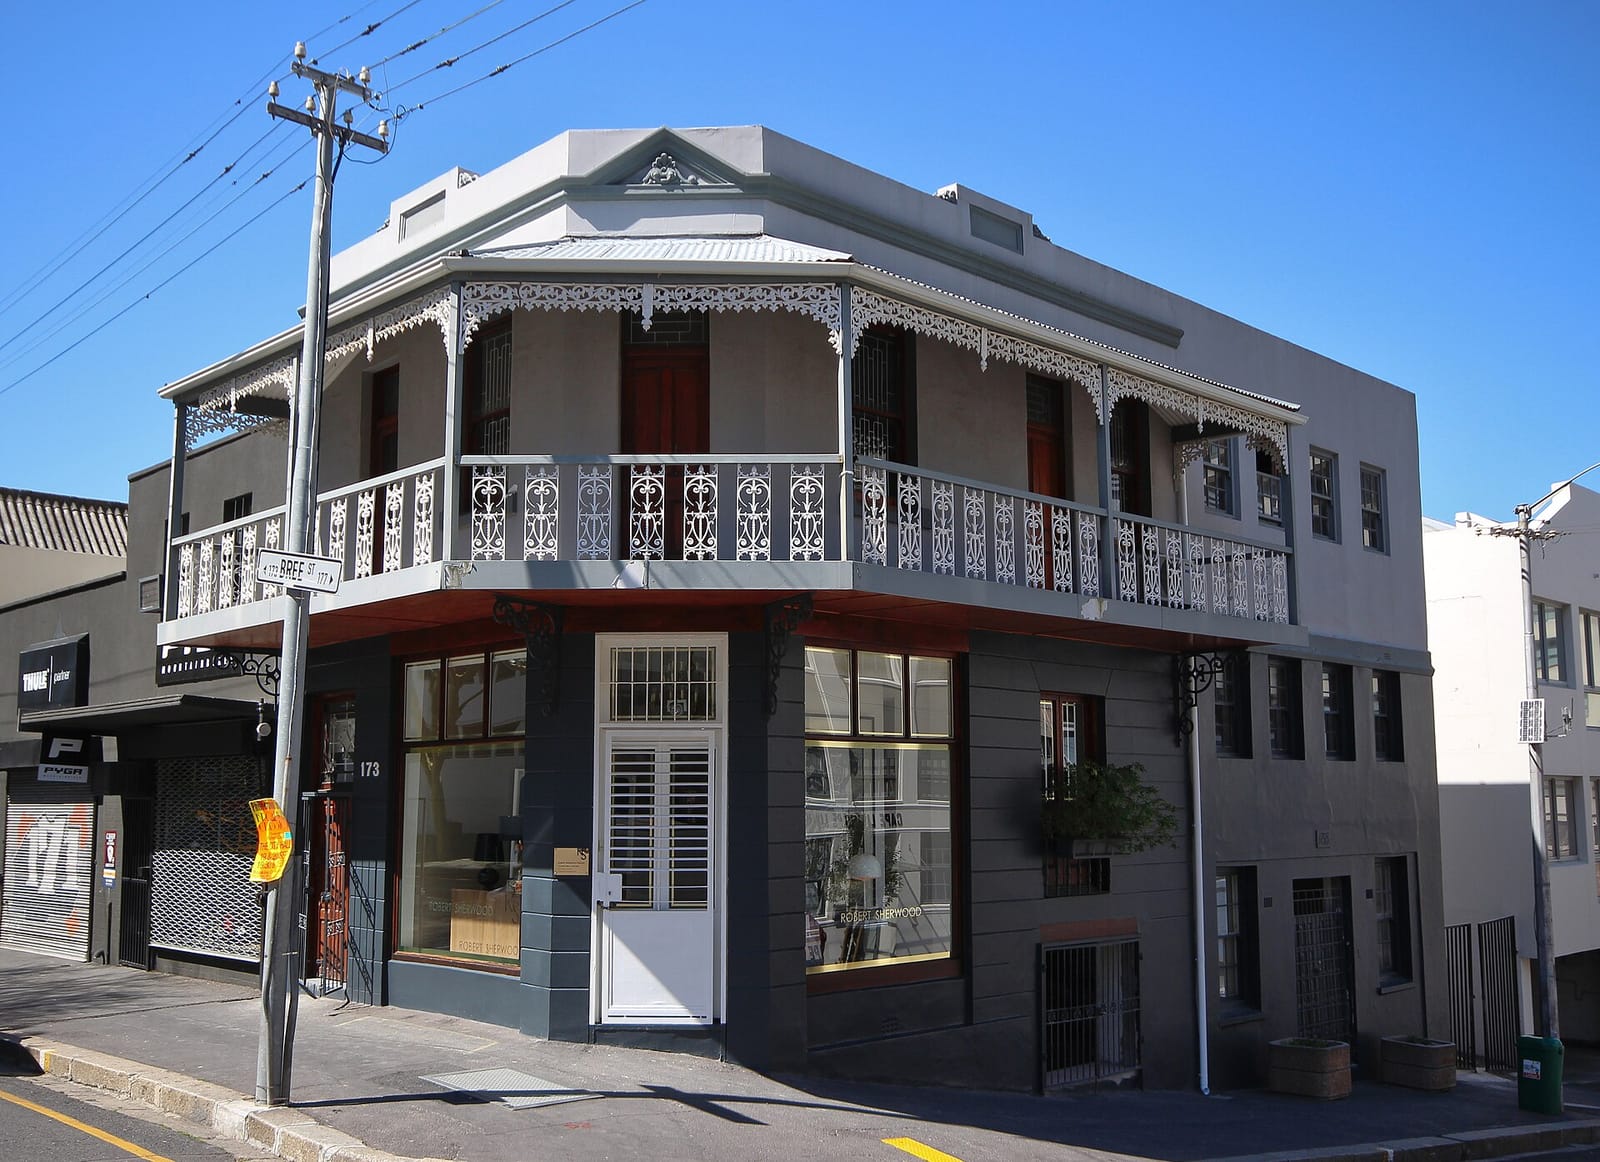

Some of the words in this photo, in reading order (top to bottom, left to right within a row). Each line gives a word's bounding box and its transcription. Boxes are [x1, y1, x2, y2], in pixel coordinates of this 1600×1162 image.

[280, 559, 305, 581] BREE
[307, 562, 316, 576] ST
[317, 571, 329, 585] 177
[23, 670, 48, 692] THULE
[43, 766, 83, 775] PYGA
[360, 761, 380, 777] 173
[840, 910, 872, 923] ROBERT
[875, 906, 922, 920] SHERWOOD
[459, 940, 483, 953] ROBERT
